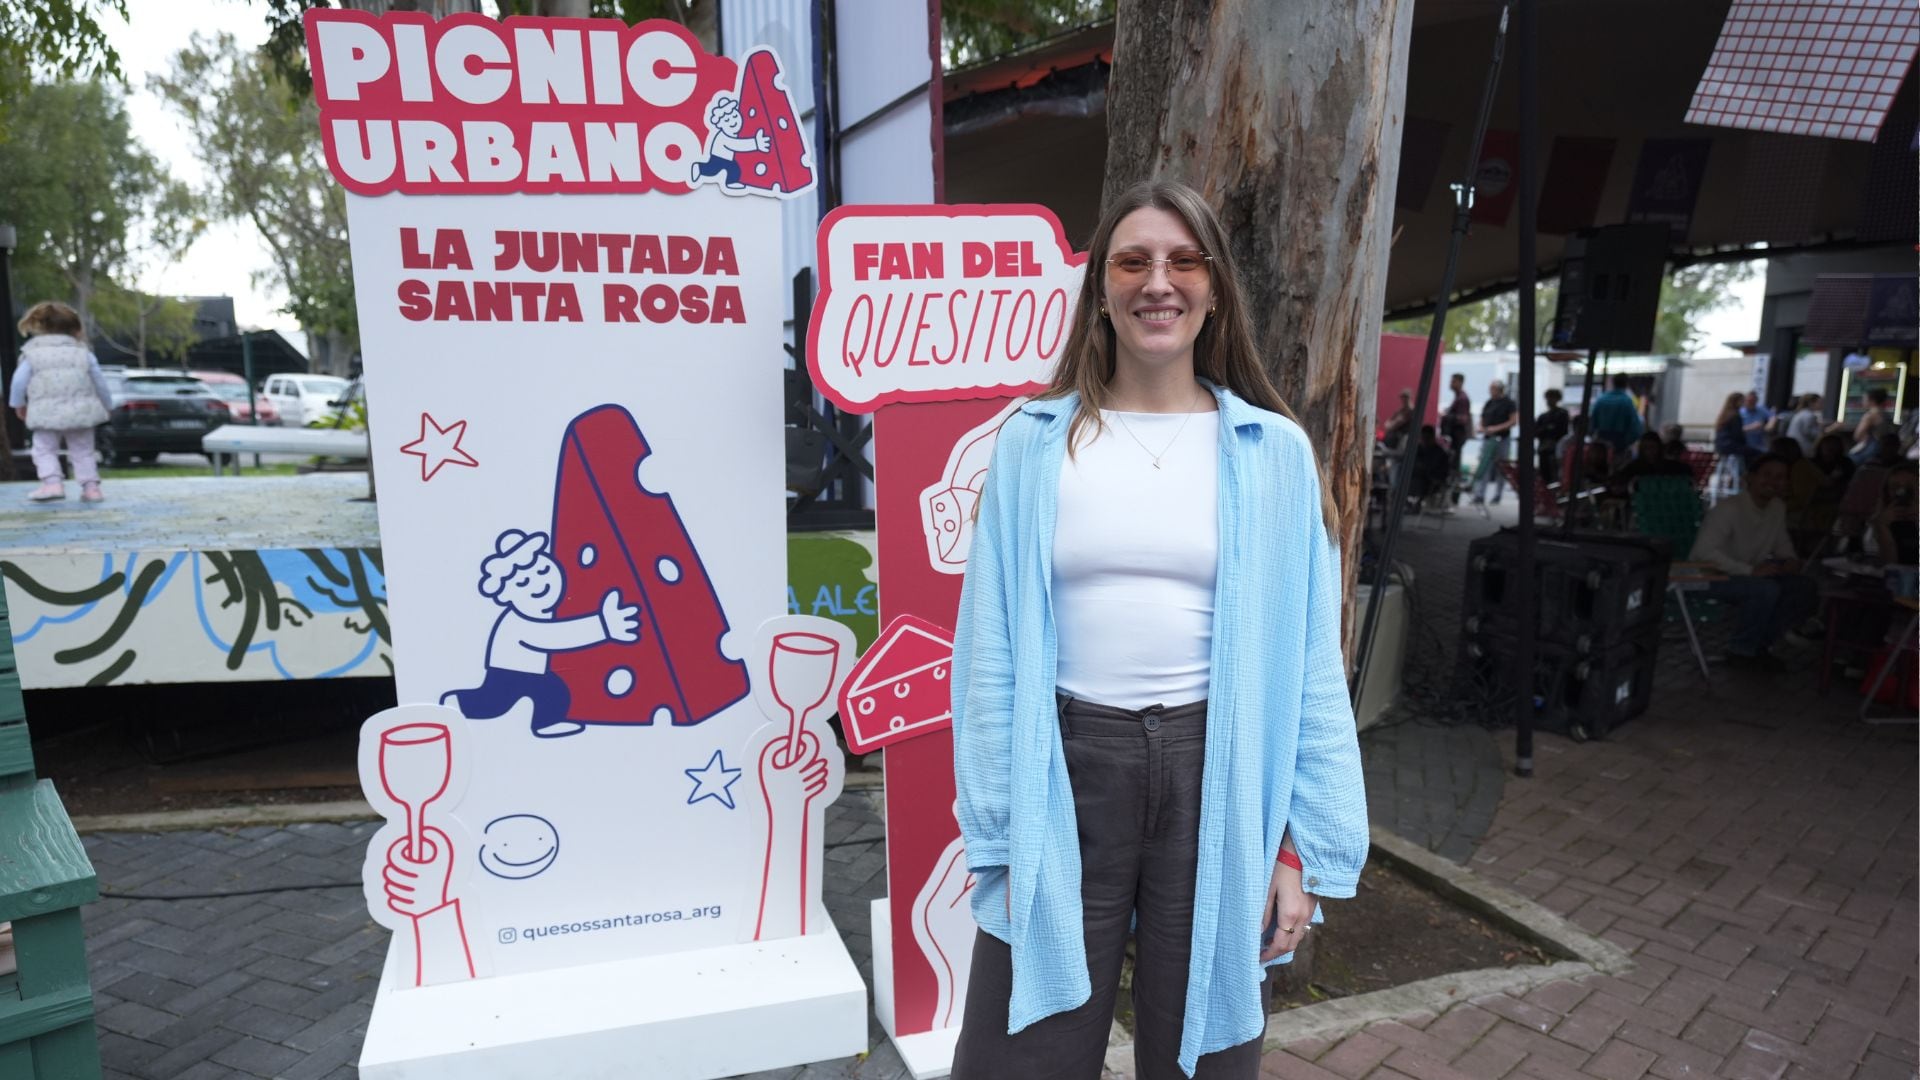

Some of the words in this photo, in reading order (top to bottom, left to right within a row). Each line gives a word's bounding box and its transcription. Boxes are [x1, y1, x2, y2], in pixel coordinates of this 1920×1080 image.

[316, 20, 697, 107] PICNIC
[331, 118, 703, 184] URBANO
[400, 227, 473, 270] LA
[494, 230, 740, 276] JUNTADA
[853, 242, 944, 281] FAN
[962, 241, 1042, 279] DEL
[398, 279, 583, 322] SANTA
[603, 284, 747, 324] ROSA
[523, 905, 721, 940] quesossantarosa_arg
